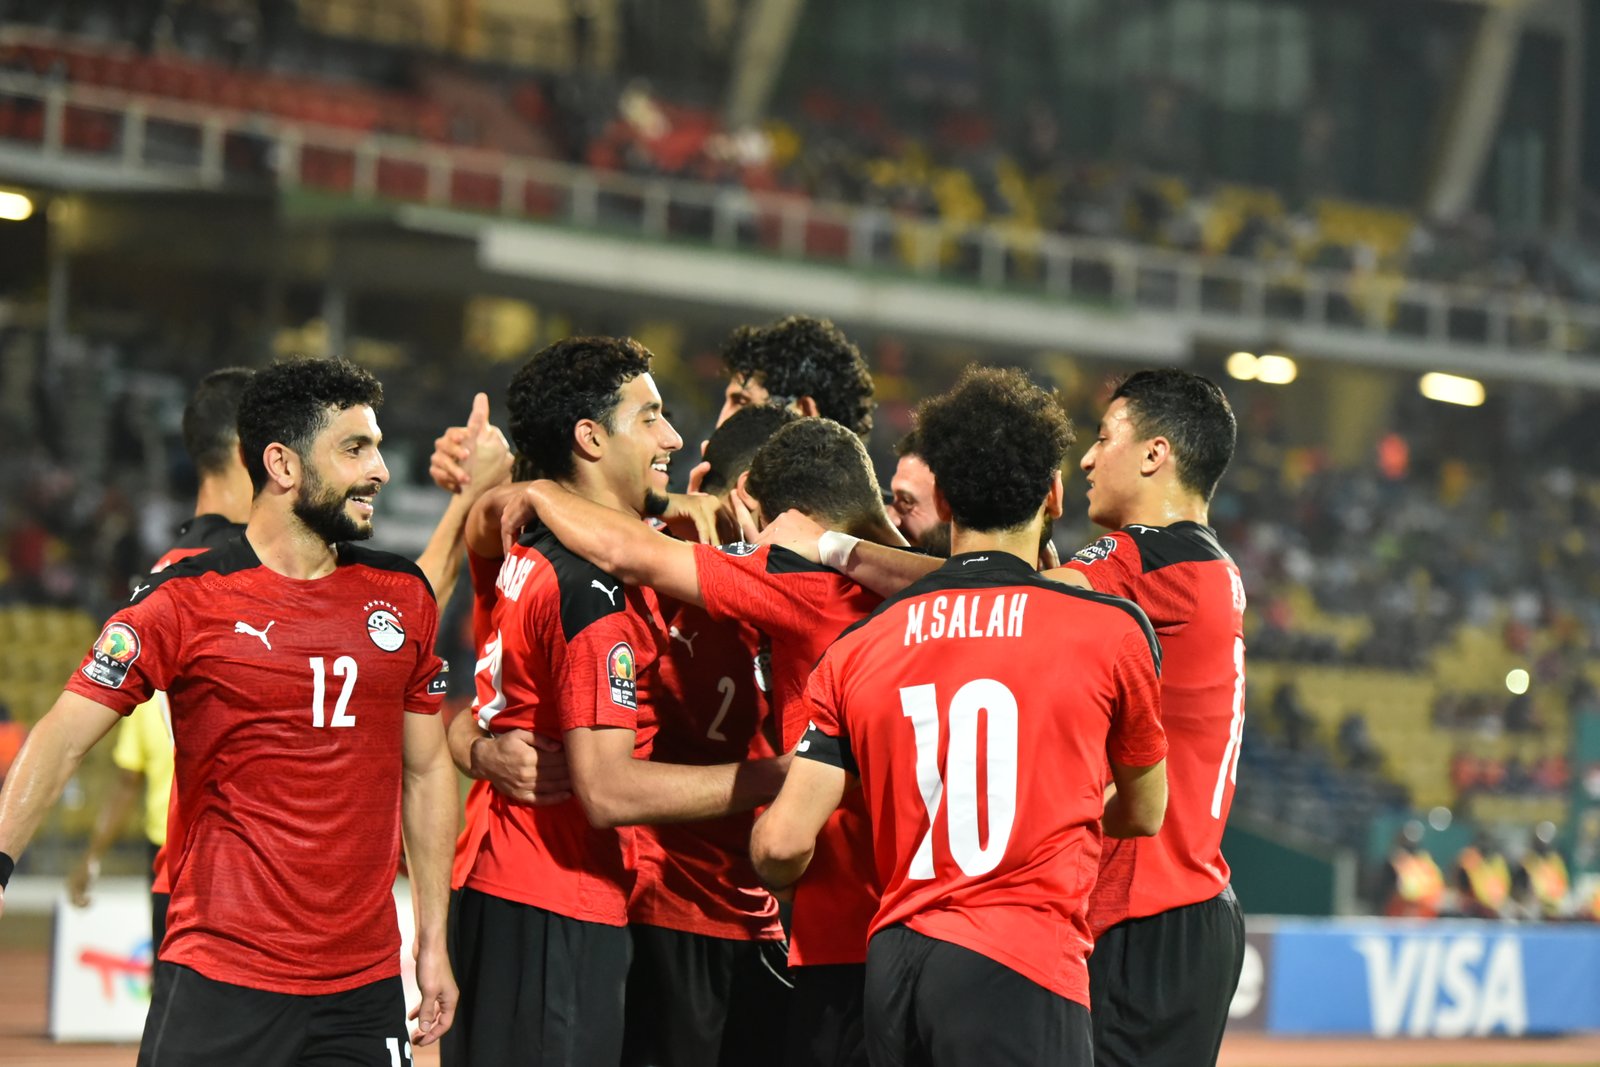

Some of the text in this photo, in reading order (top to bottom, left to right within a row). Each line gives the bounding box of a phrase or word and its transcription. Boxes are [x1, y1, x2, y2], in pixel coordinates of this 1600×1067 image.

[904, 593, 1028, 646] M.SALAH
[309, 656, 359, 728] 12
[433, 680, 448, 689] CA
[706, 676, 736, 742] 2
[1211, 636, 1246, 820] 1
[899, 678, 1018, 881] 10
[1354, 931, 1528, 1039] VISA
